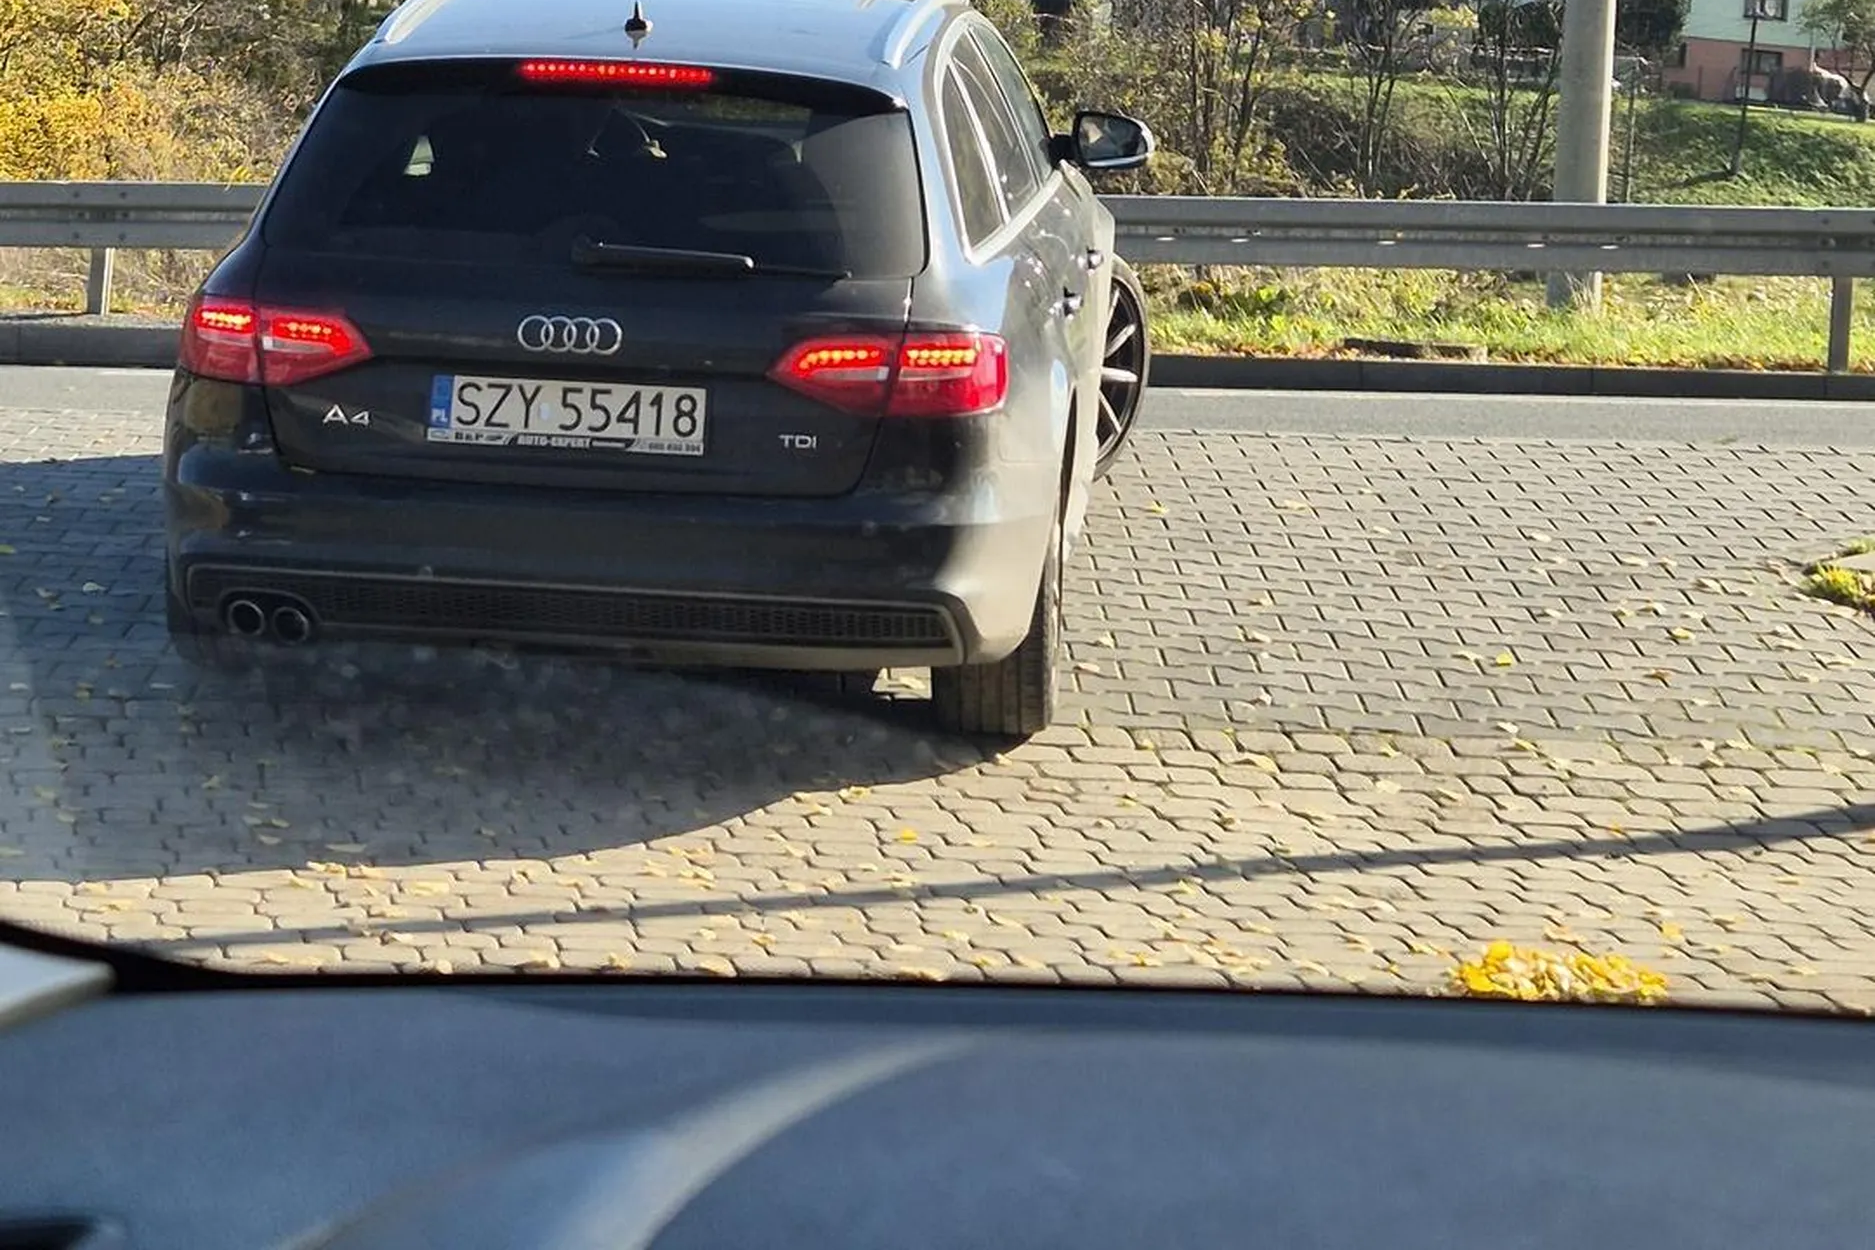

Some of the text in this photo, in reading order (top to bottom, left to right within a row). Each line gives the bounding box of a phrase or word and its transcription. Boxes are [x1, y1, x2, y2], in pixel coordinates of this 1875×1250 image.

[322, 403, 369, 426] A4
[431, 408, 448, 423] PL
[456, 381, 698, 438] SZY 55418
[778, 434, 817, 449] TDI
